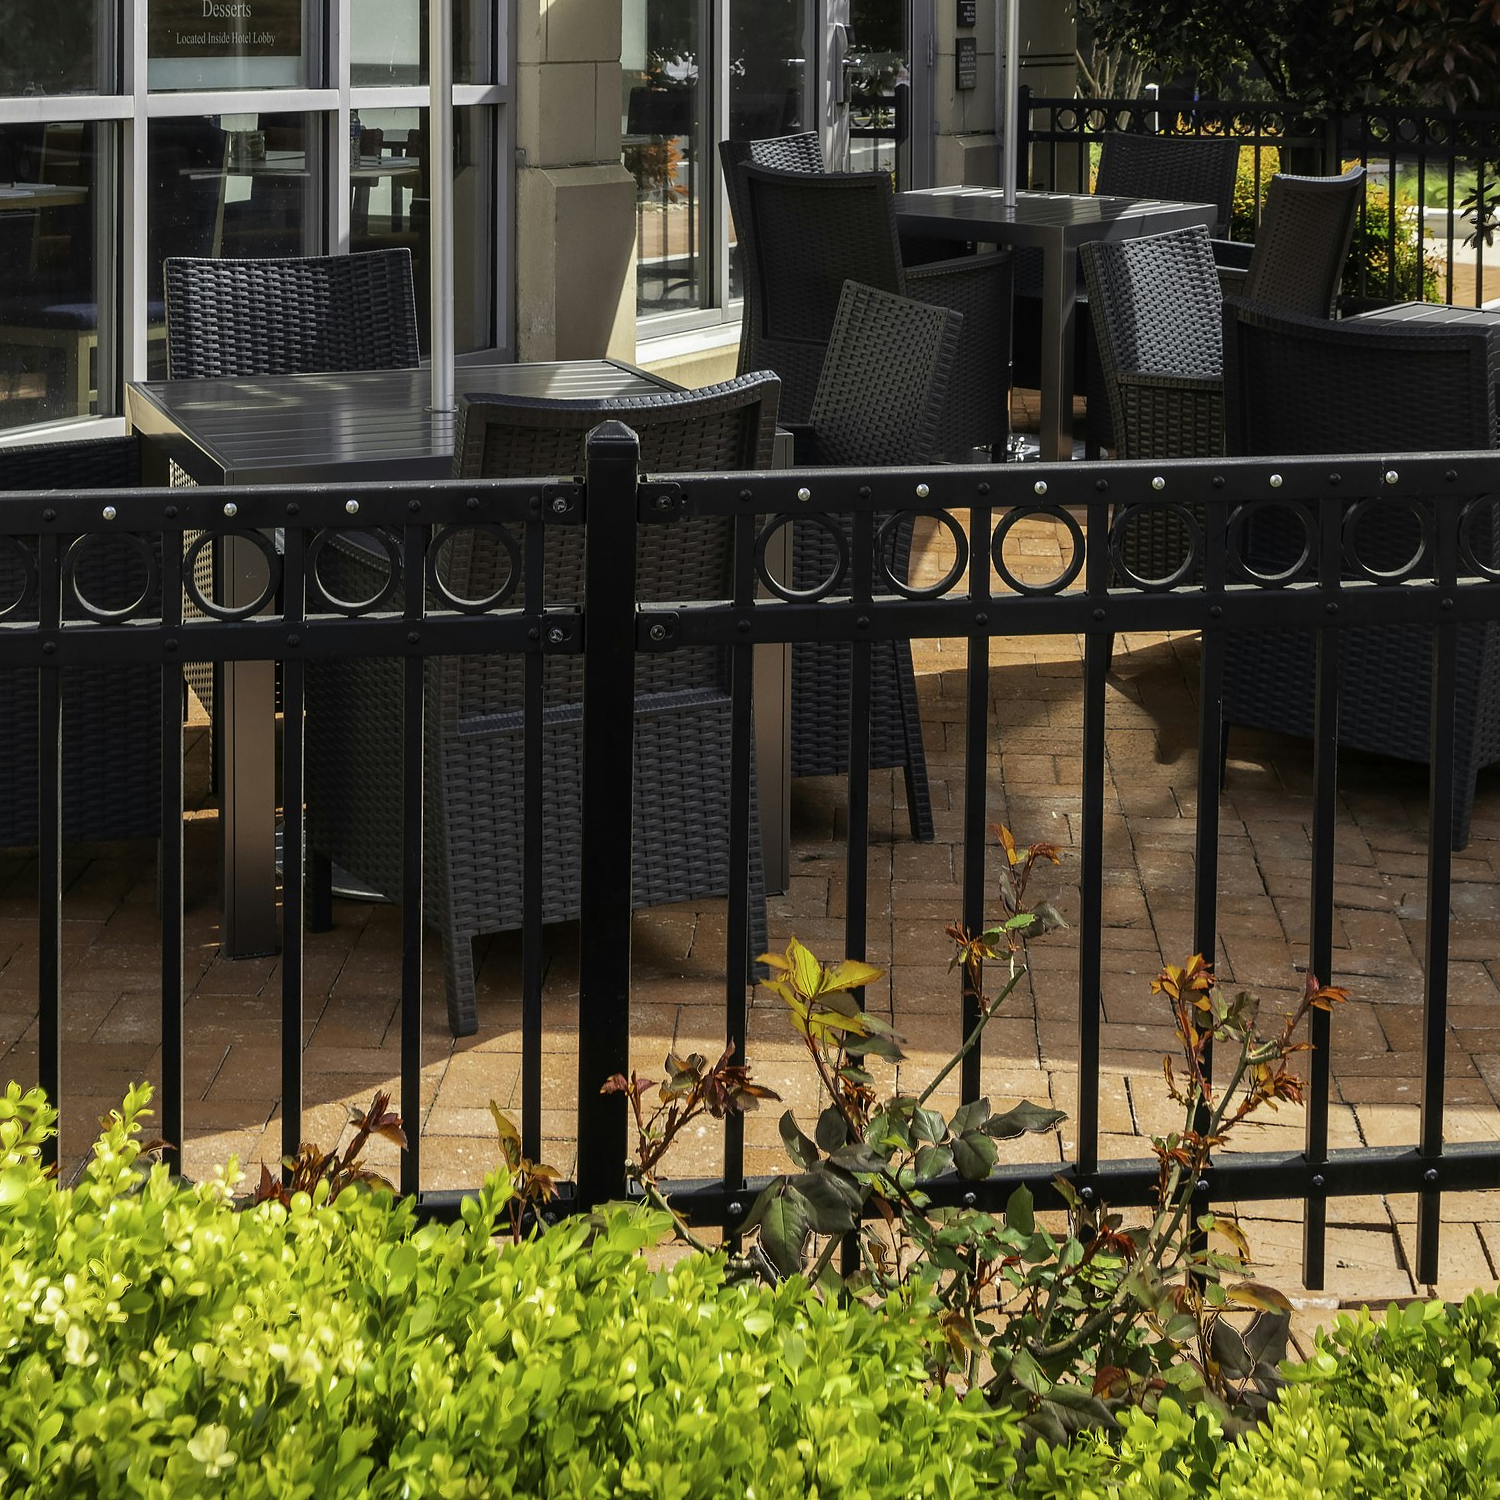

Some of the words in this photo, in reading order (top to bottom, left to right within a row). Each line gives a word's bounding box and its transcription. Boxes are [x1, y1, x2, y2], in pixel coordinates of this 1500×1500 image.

[202, 0, 252, 18] Desserts
[176, 32, 206, 45] Located
[208, 32, 230, 44] Inside
[231, 32, 251, 44] Hotel
[253, 32, 276, 47] Lobby
